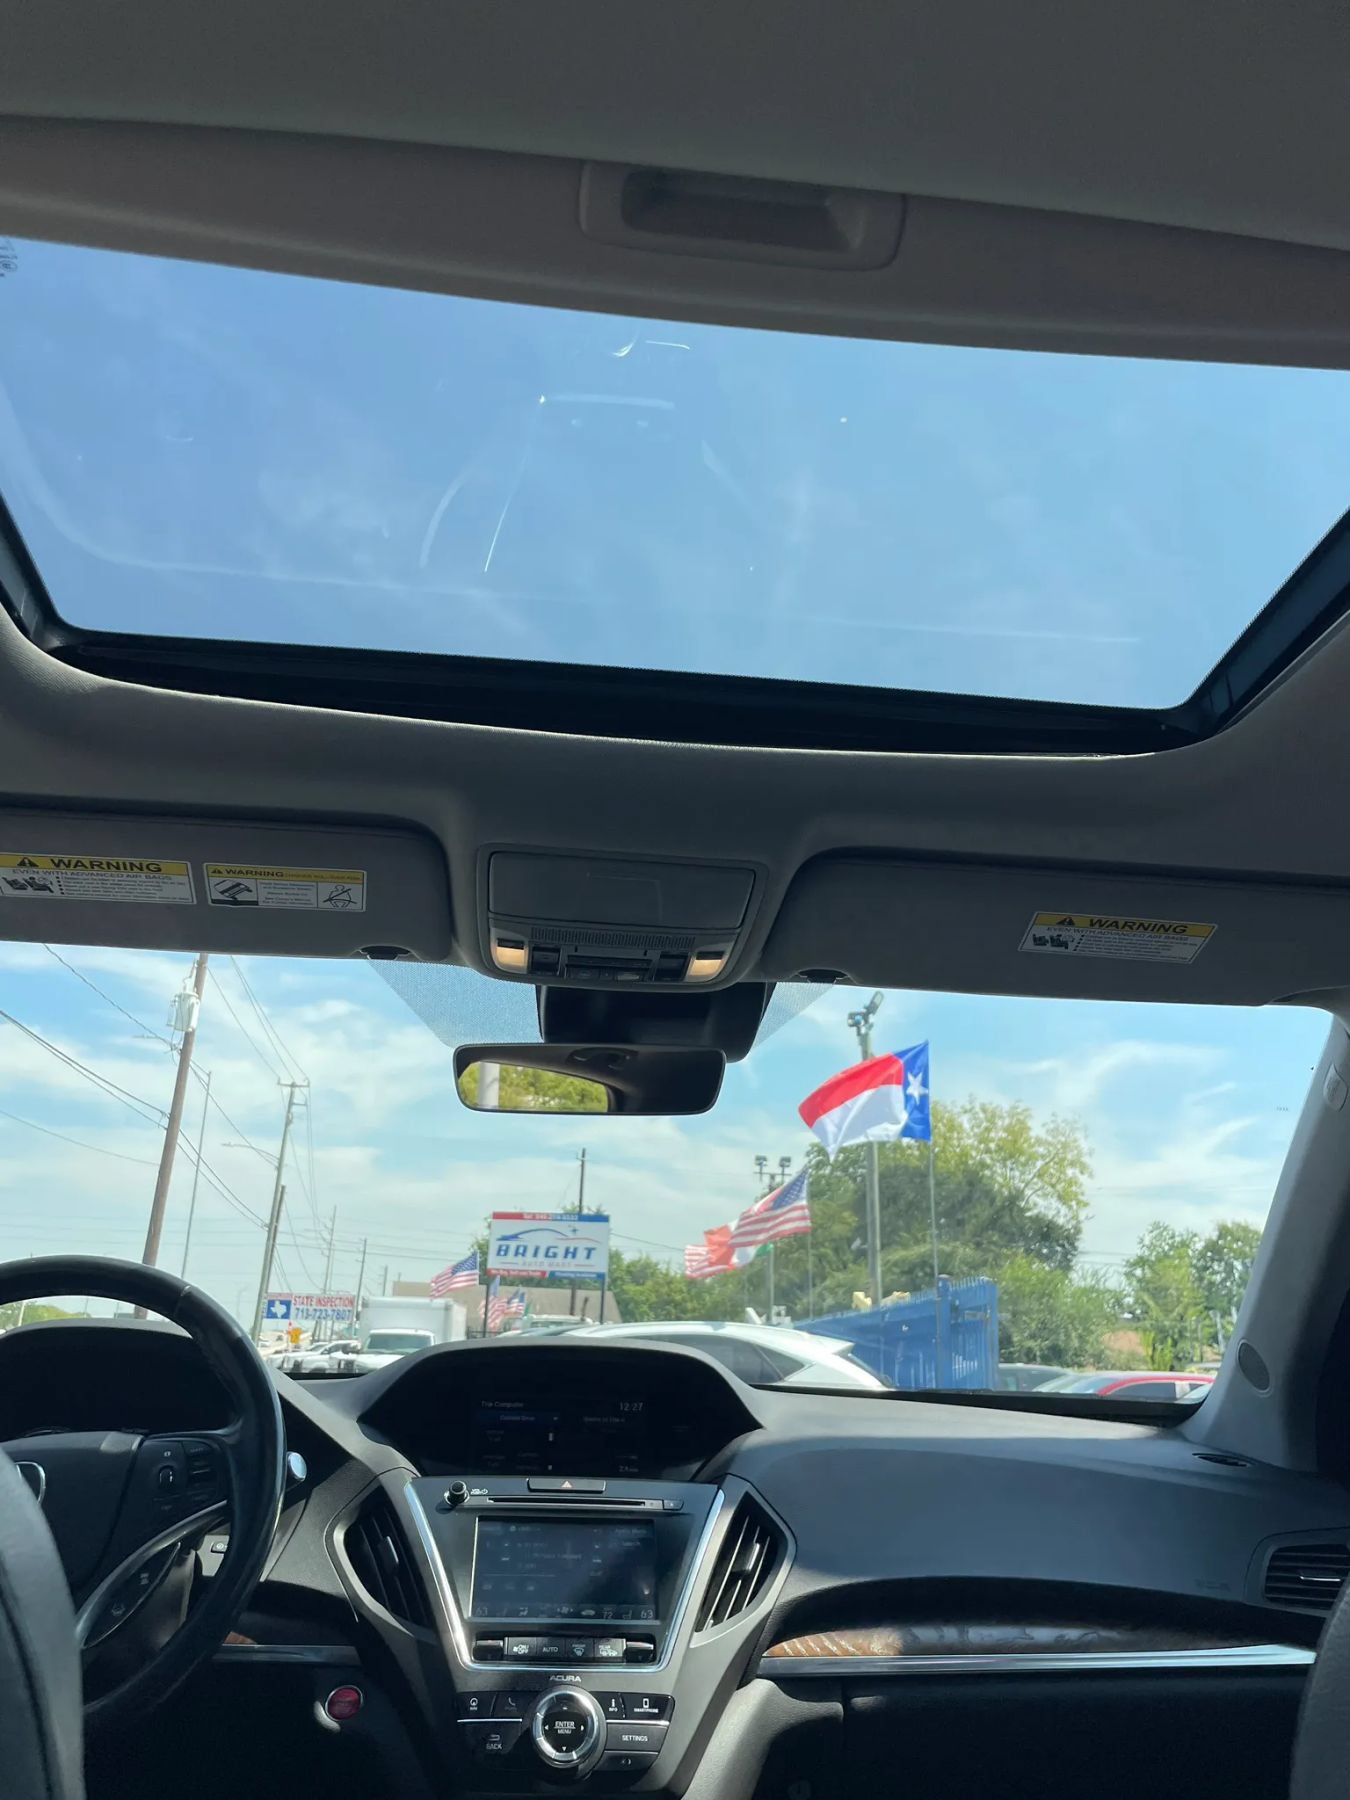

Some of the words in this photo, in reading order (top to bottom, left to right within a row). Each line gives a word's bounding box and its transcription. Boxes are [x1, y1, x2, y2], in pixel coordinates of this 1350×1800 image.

[50, 858, 163, 873] WARNING
[42, 870, 69, 878] WITH
[70, 872, 125, 880] ADVANCED
[225, 867, 285, 879] WARNING
[1088, 918, 1189, 934] WARNING
[496, 1244, 597, 1259] BRIGHT
[294, 1295, 314, 1306] STATE
[316, 1296, 353, 1307] INSPECTION
[640, 1608, 654, 1618] 63
[542, 1645, 559, 1654] AUTO
[549, 1674, 583, 1683] ACURA
[556, 1720, 575, 1728] ENTER
[621, 1734, 649, 1743] SETTINGS
